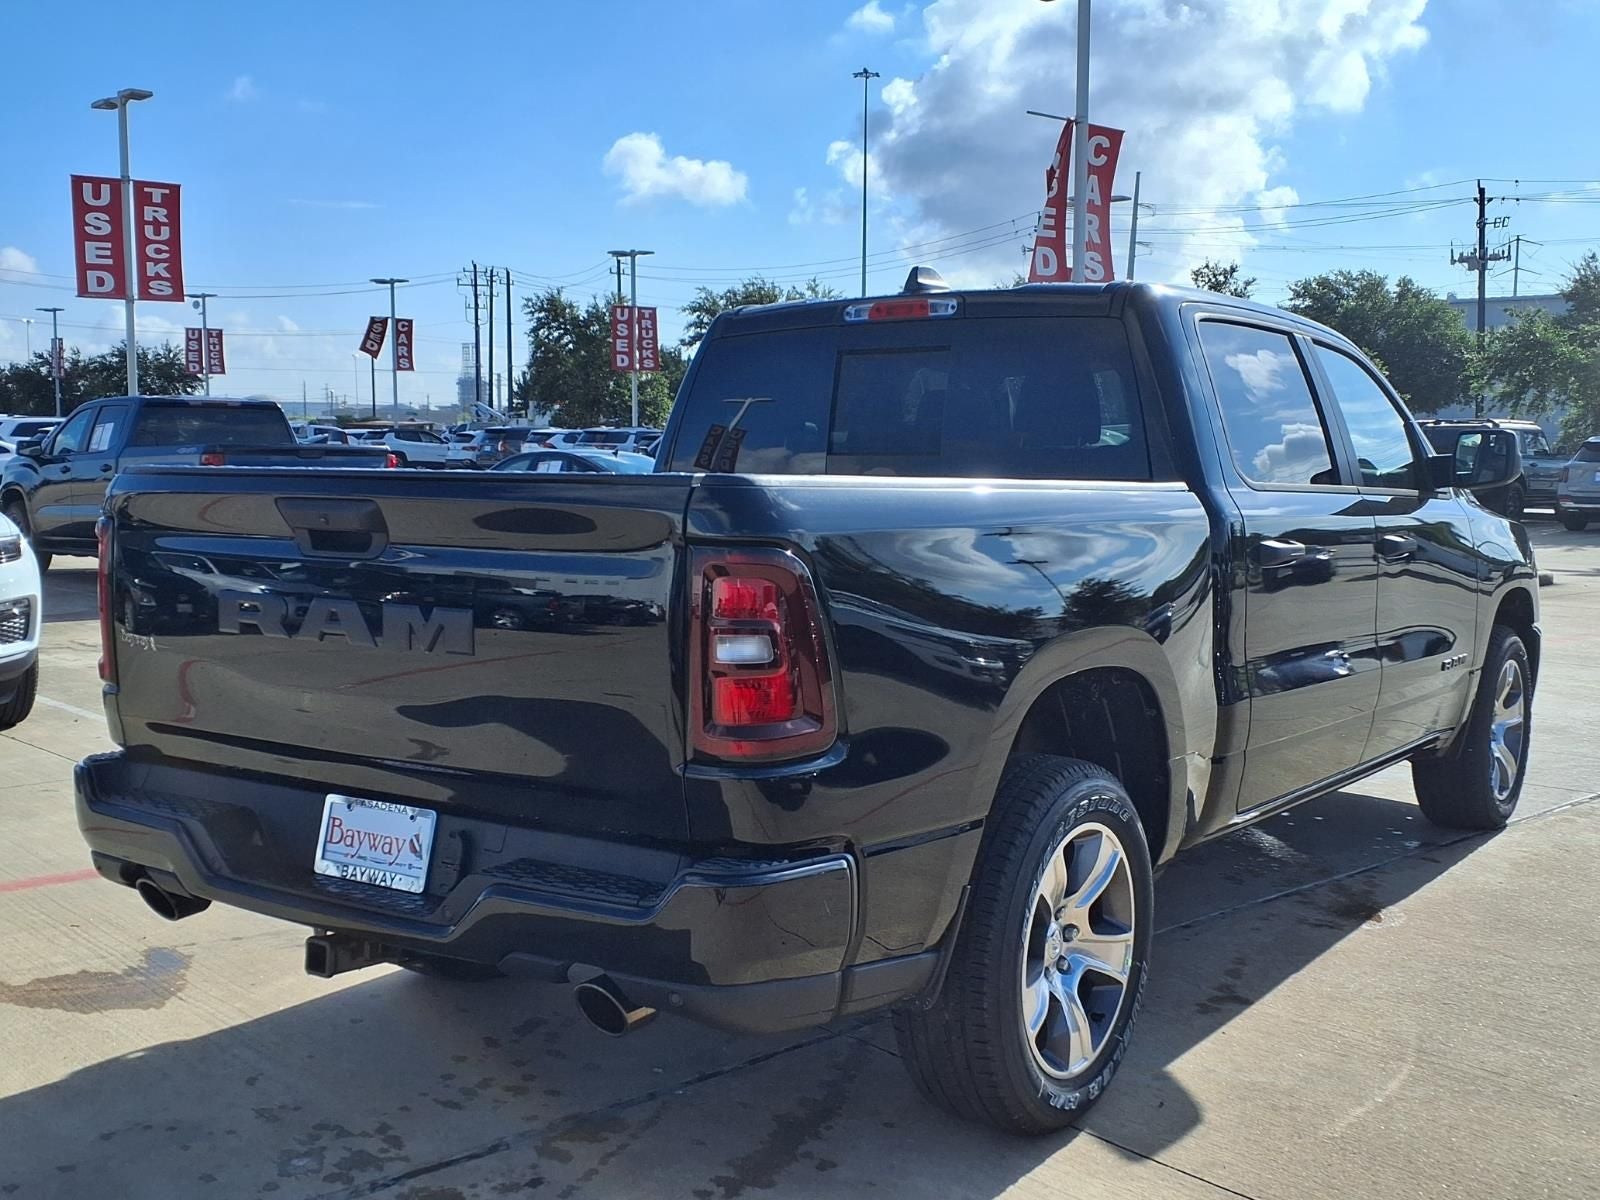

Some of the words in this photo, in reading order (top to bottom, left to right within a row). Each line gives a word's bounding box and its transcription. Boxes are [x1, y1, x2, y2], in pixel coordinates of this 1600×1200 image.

[1084, 135, 1111, 281] CARS
[82, 182, 115, 293] USED
[143, 187, 174, 296] TRUCKS
[187, 329, 200, 372] USED
[208, 330, 222, 373] TRUCKS
[365, 318, 384, 351] SED
[397, 321, 410, 369] CARS
[615, 307, 630, 367] USED
[641, 309, 655, 368] TRUCKS
[218, 588, 475, 656] RAM
[328, 816, 406, 866] Bayway
[340, 864, 397, 888] BAYWAY
